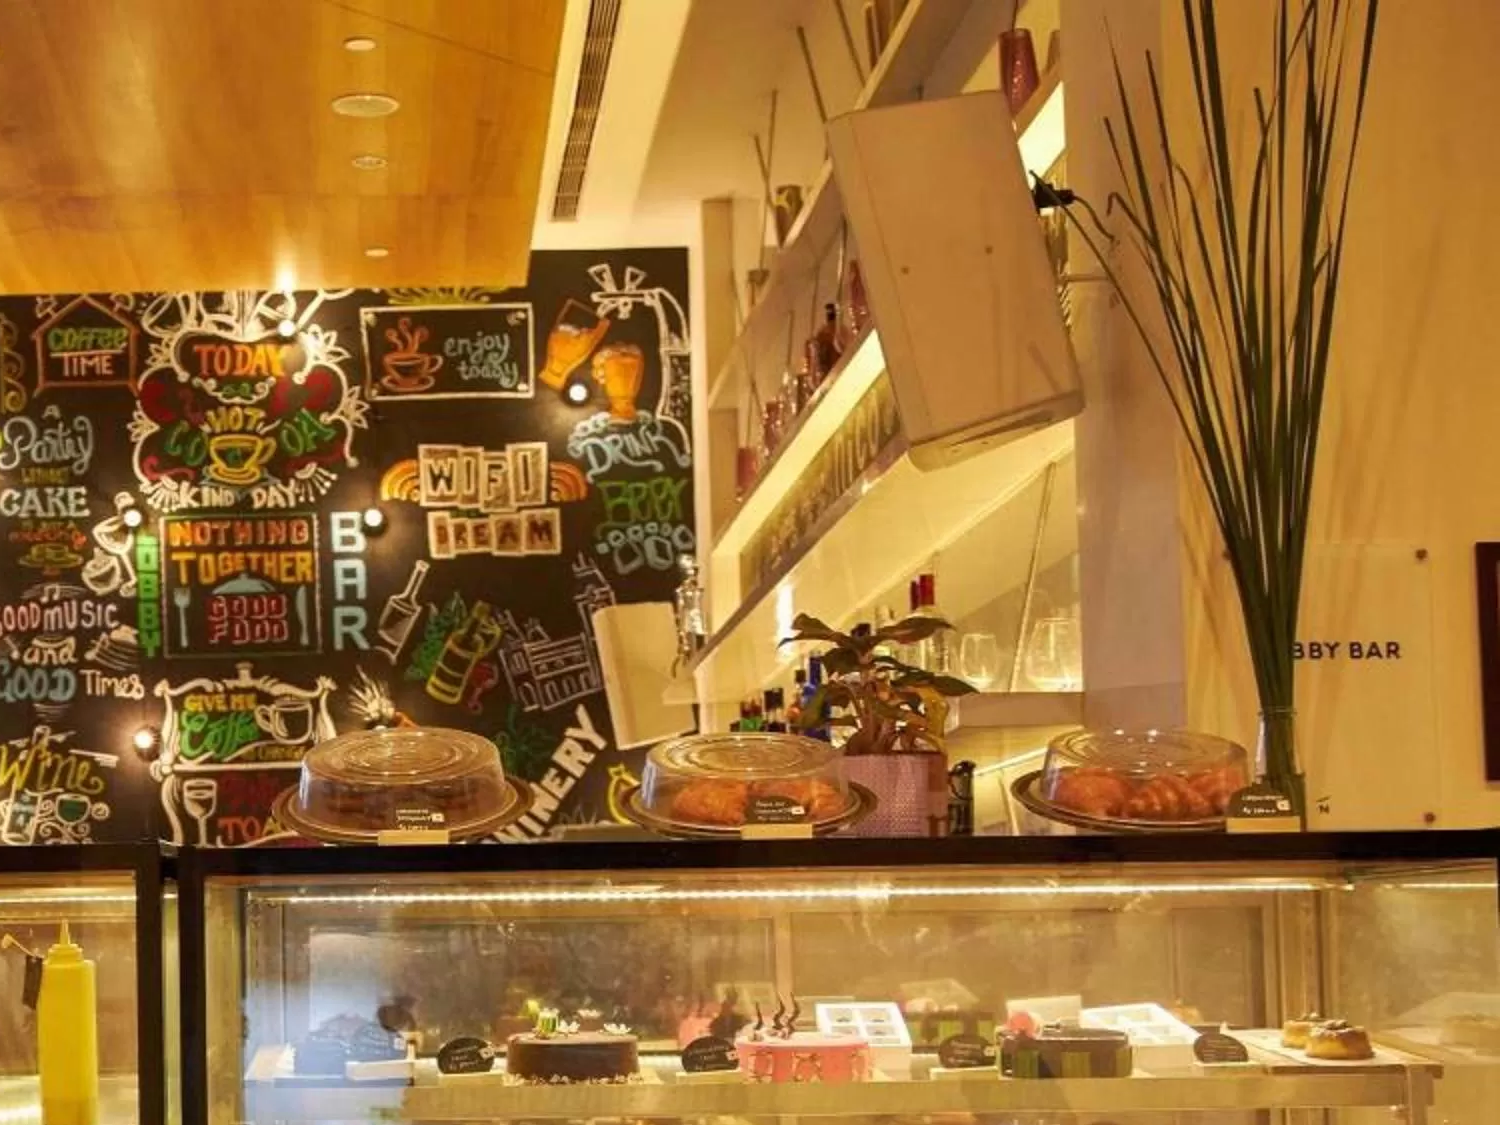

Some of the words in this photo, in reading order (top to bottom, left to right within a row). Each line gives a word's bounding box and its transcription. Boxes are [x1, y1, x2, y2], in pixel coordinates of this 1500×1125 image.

[63, 353, 114, 377] TIME
[194, 343, 287, 377] TODAY
[444, 331, 512, 365] enjoy
[456, 359, 519, 389] today
[205, 406, 266, 433] HOT
[582, 427, 678, 484] DRINK
[421, 451, 534, 501] WIFI
[169, 520, 310, 546] NOTHING
[171, 551, 314, 586] TOGETHER
[330, 511, 370, 651] BAR
[1349, 641, 1402, 660] BAR
